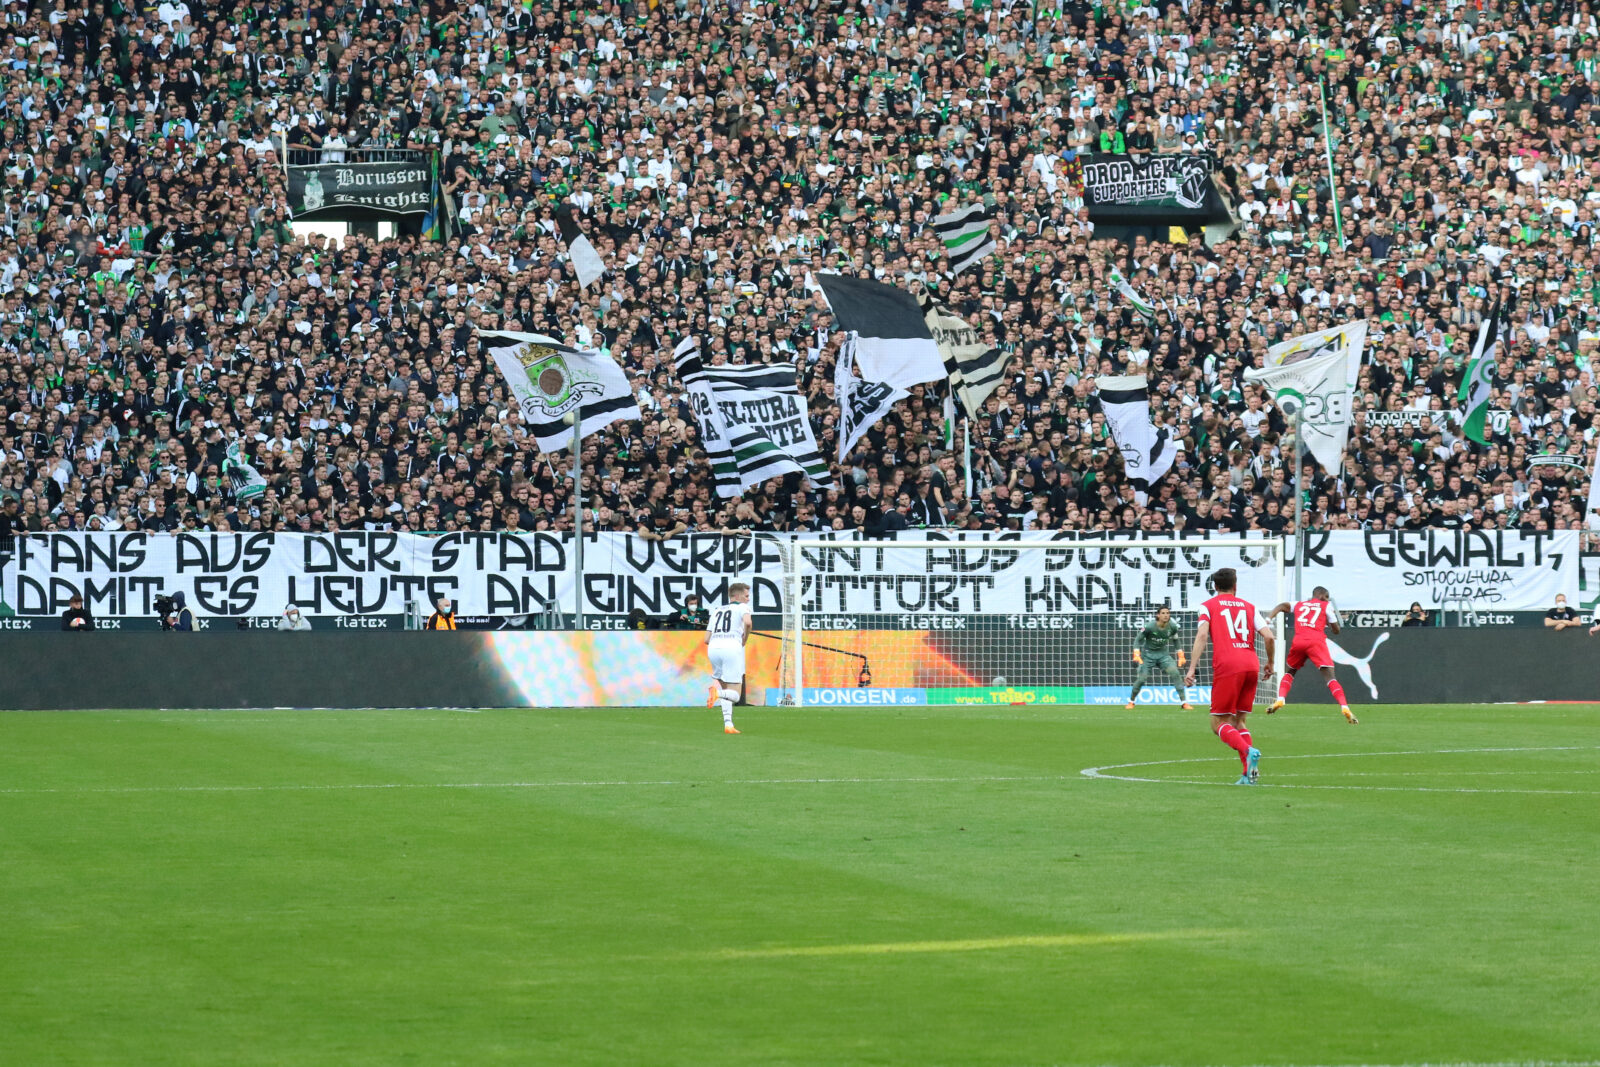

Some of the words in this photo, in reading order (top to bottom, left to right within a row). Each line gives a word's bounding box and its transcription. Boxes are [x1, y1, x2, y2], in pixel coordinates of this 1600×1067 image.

[335, 168, 427, 189] Borussen
[1094, 178, 1167, 202] SUPPORTERS
[334, 191, 430, 208] Knights
[20, 533, 147, 573] FANS
[176, 533, 275, 573] AUS
[304, 532, 400, 573] DER
[432, 532, 598, 572] STADT
[926, 531, 1021, 573] AUS
[1045, 529, 1211, 572] SORGE
[1364, 529, 1563, 571] GEWALT,
[17, 574, 164, 616] DAMIT
[194, 575, 259, 615] ES
[288, 574, 459, 615] HEUTE
[487, 573, 556, 614] AN
[584, 573, 729, 613] EINEM
[752, 574, 995, 613] DRITTORT
[334, 616, 387, 628] flatex
[714, 609, 732, 633] 28
[801, 614, 857, 629] latex
[899, 614, 966, 629] flatex
[1007, 614, 1074, 629] flatex
[1297, 605, 1322, 625] 27
[1464, 613, 1514, 625] fatex
[1220, 608, 1250, 641] 14
[809, 689, 896, 704] JONGEN
[1127, 688, 1211, 703] ONGEN
